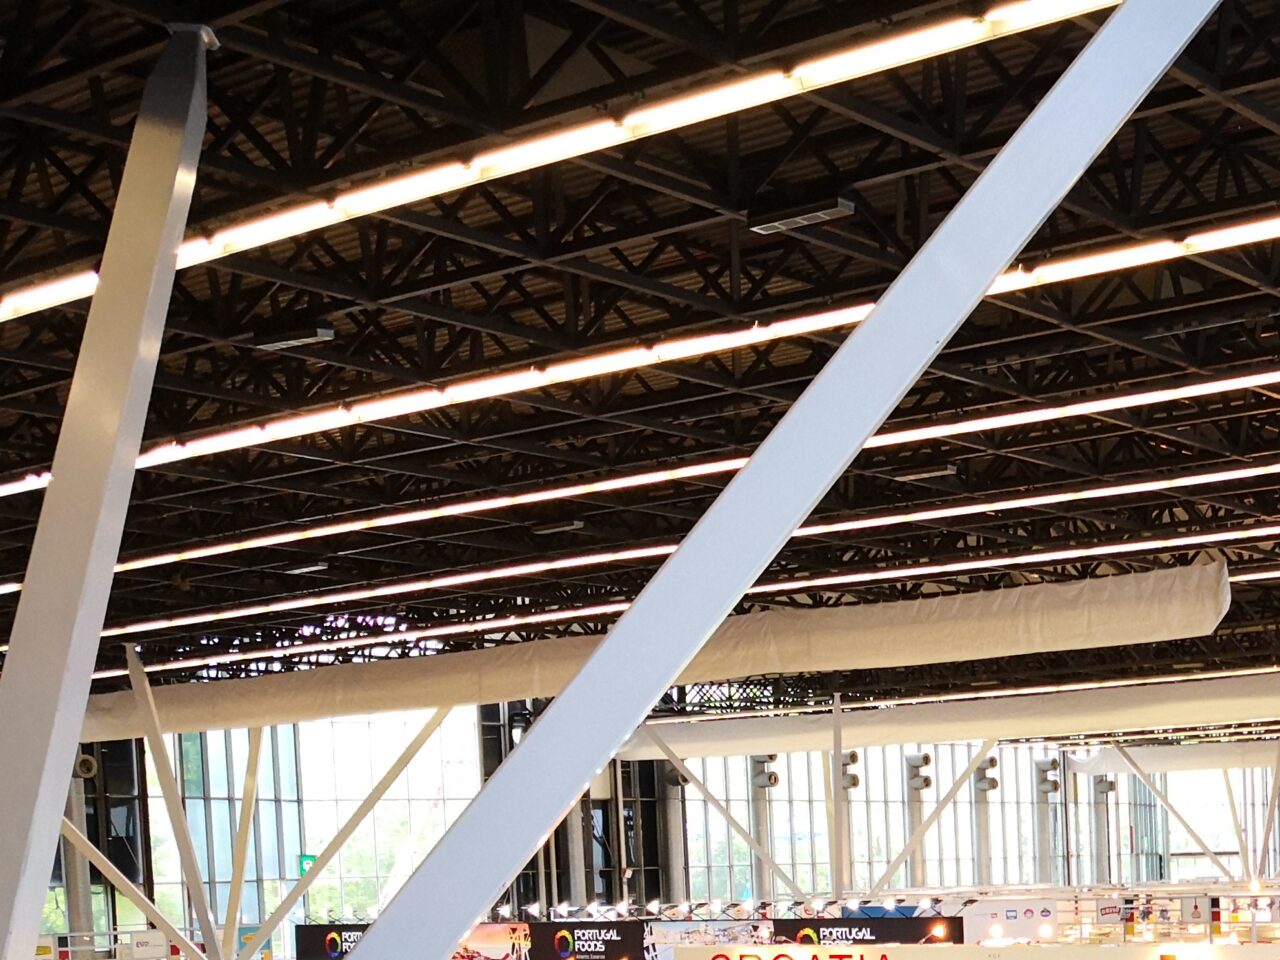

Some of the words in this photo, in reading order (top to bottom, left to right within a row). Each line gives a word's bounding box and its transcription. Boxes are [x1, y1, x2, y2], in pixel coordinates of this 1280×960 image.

[341, 931, 363, 941] PORT
[574, 929, 621, 940] PORTUGAL
[819, 927, 876, 940] PORTUGAL
[574, 941, 605, 952] FOODS
